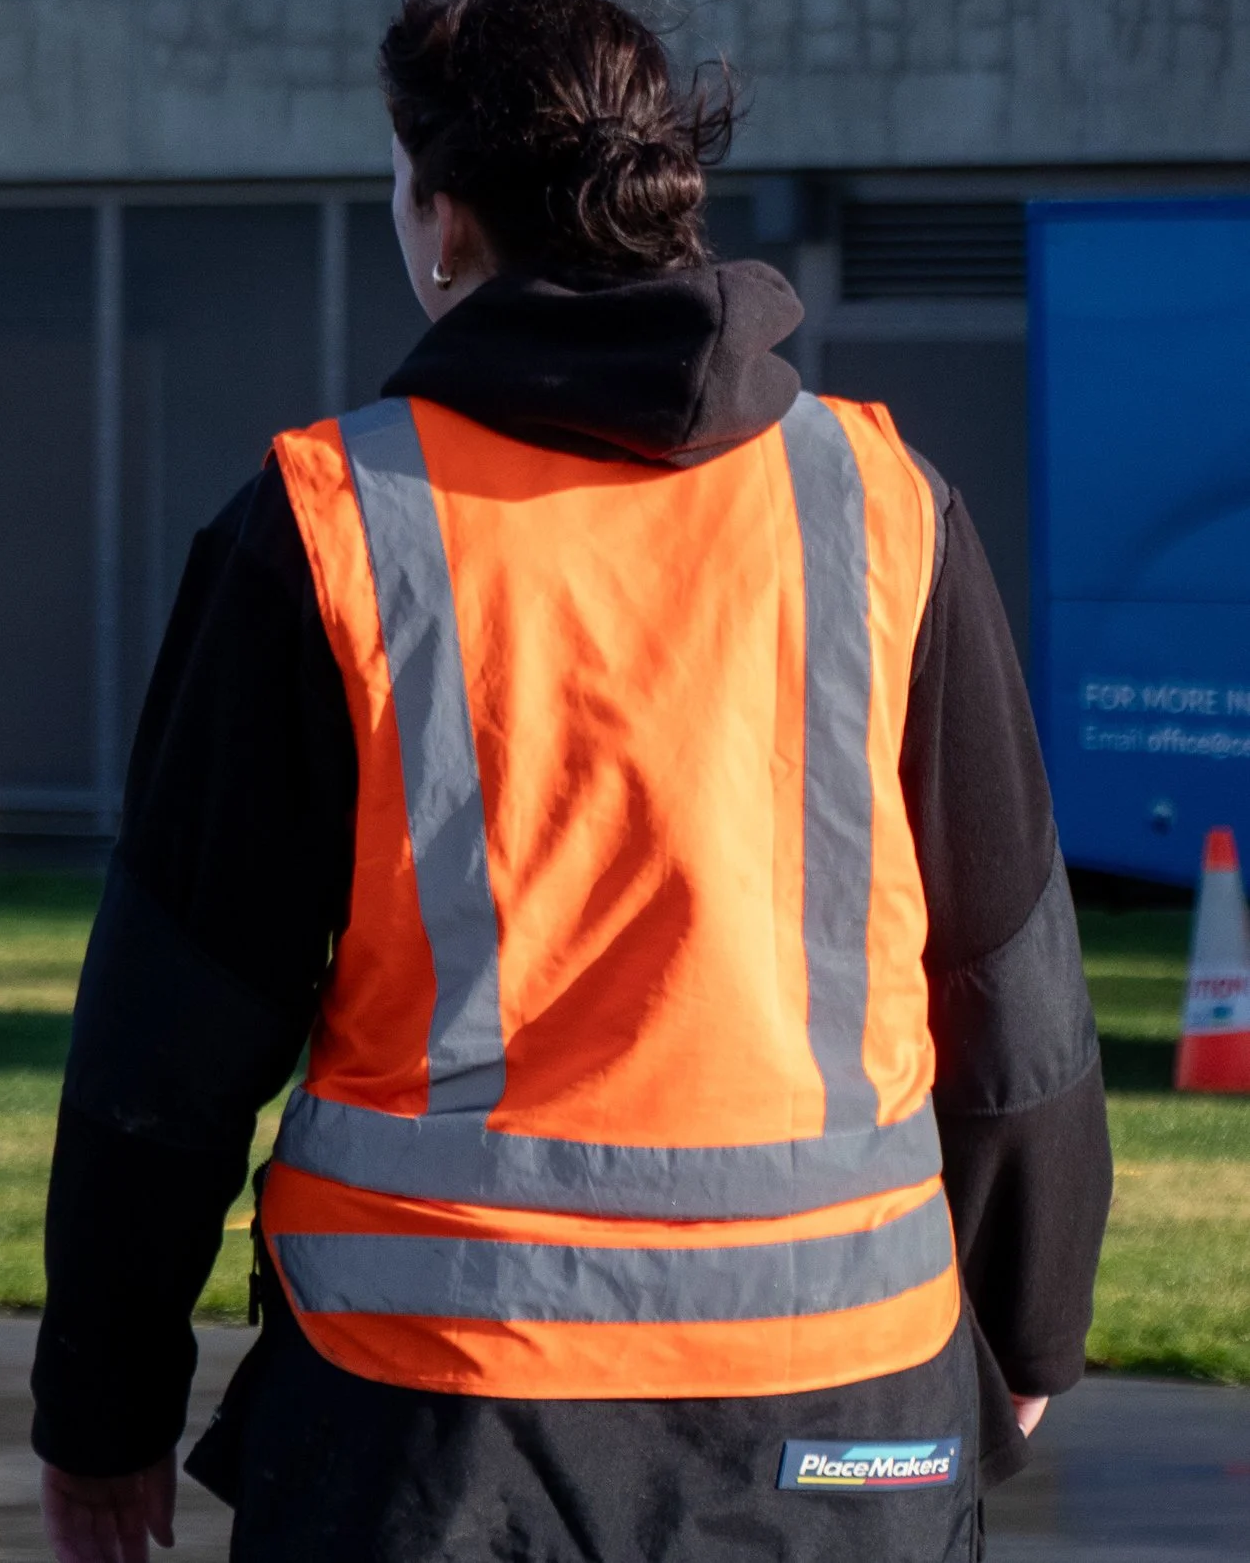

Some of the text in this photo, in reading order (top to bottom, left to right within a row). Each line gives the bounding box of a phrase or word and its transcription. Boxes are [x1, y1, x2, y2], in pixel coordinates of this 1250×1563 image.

[1086, 684, 1136, 711] FOR
[1143, 685, 1218, 714] MORE
[799, 1453, 950, 1478] PlaceMakers
